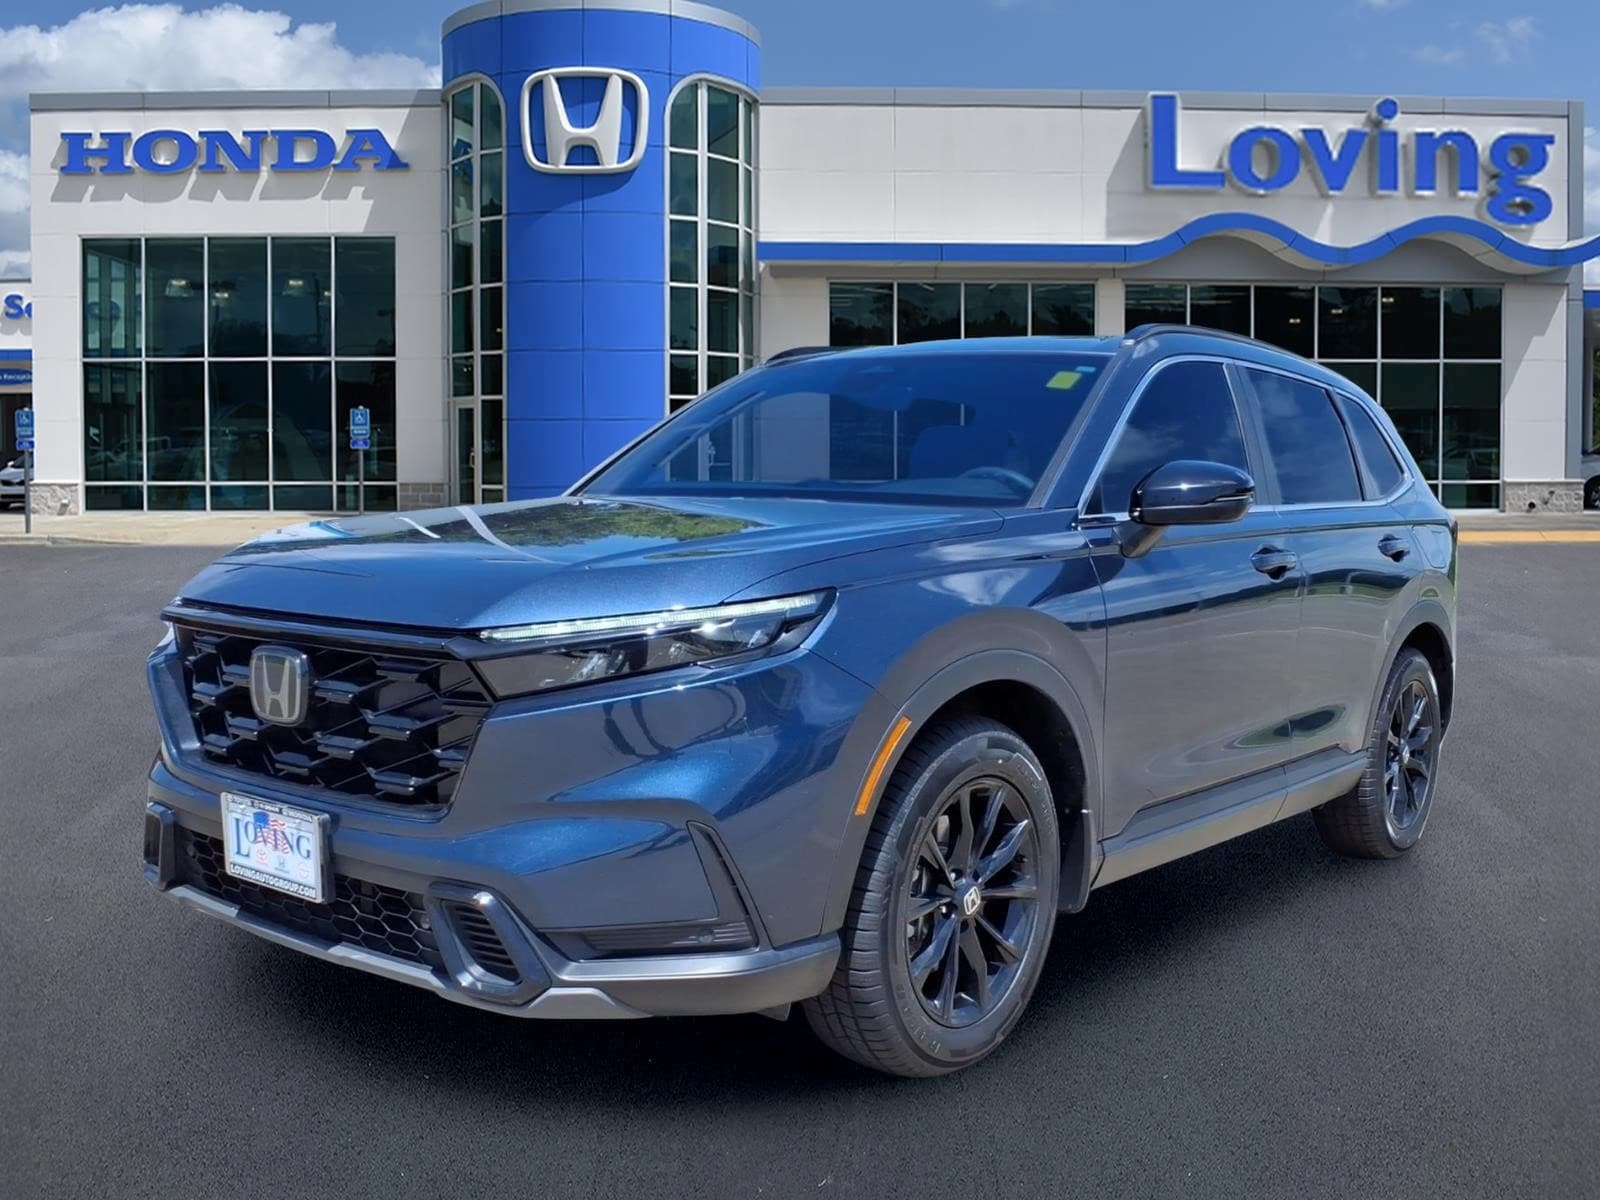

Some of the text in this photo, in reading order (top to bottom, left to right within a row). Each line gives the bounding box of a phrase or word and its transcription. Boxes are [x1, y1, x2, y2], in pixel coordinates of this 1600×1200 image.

[60, 129, 410, 174] HONDA
[1149, 93, 1556, 226] Loving
[233, 818, 312, 860] LOVING
[230, 863, 317, 899] LOVINGAUTOGROUP.COM
